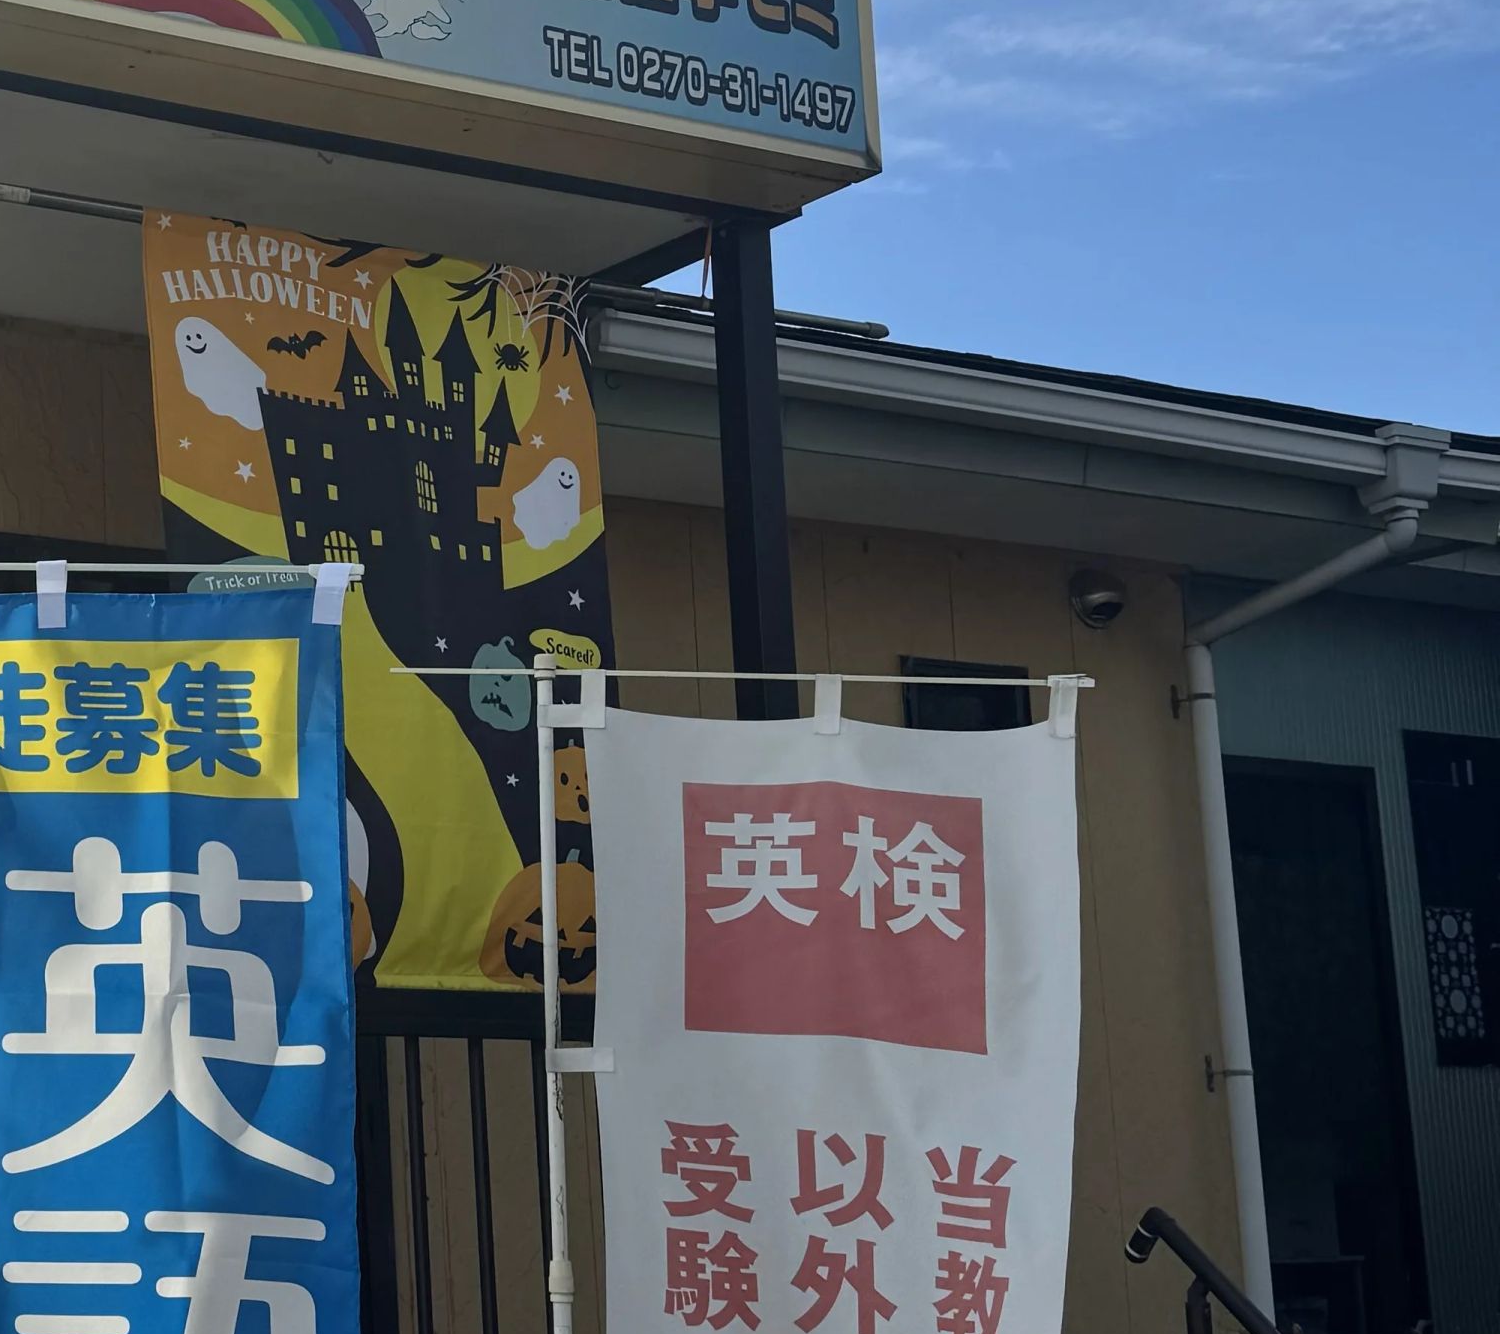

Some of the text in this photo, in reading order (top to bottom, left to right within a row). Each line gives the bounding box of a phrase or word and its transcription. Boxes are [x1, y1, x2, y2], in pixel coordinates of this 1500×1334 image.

[544, 26, 854, 132] TEL 0270-31-1497
[206, 230, 326, 281] HAPPY
[161, 268, 373, 330] HALLOWEEN
[205, 574, 245, 591] Trick
[247, 574, 260, 585] or
[546, 637, 595, 666] Scared?
[704, 812, 967, 941] 英検
